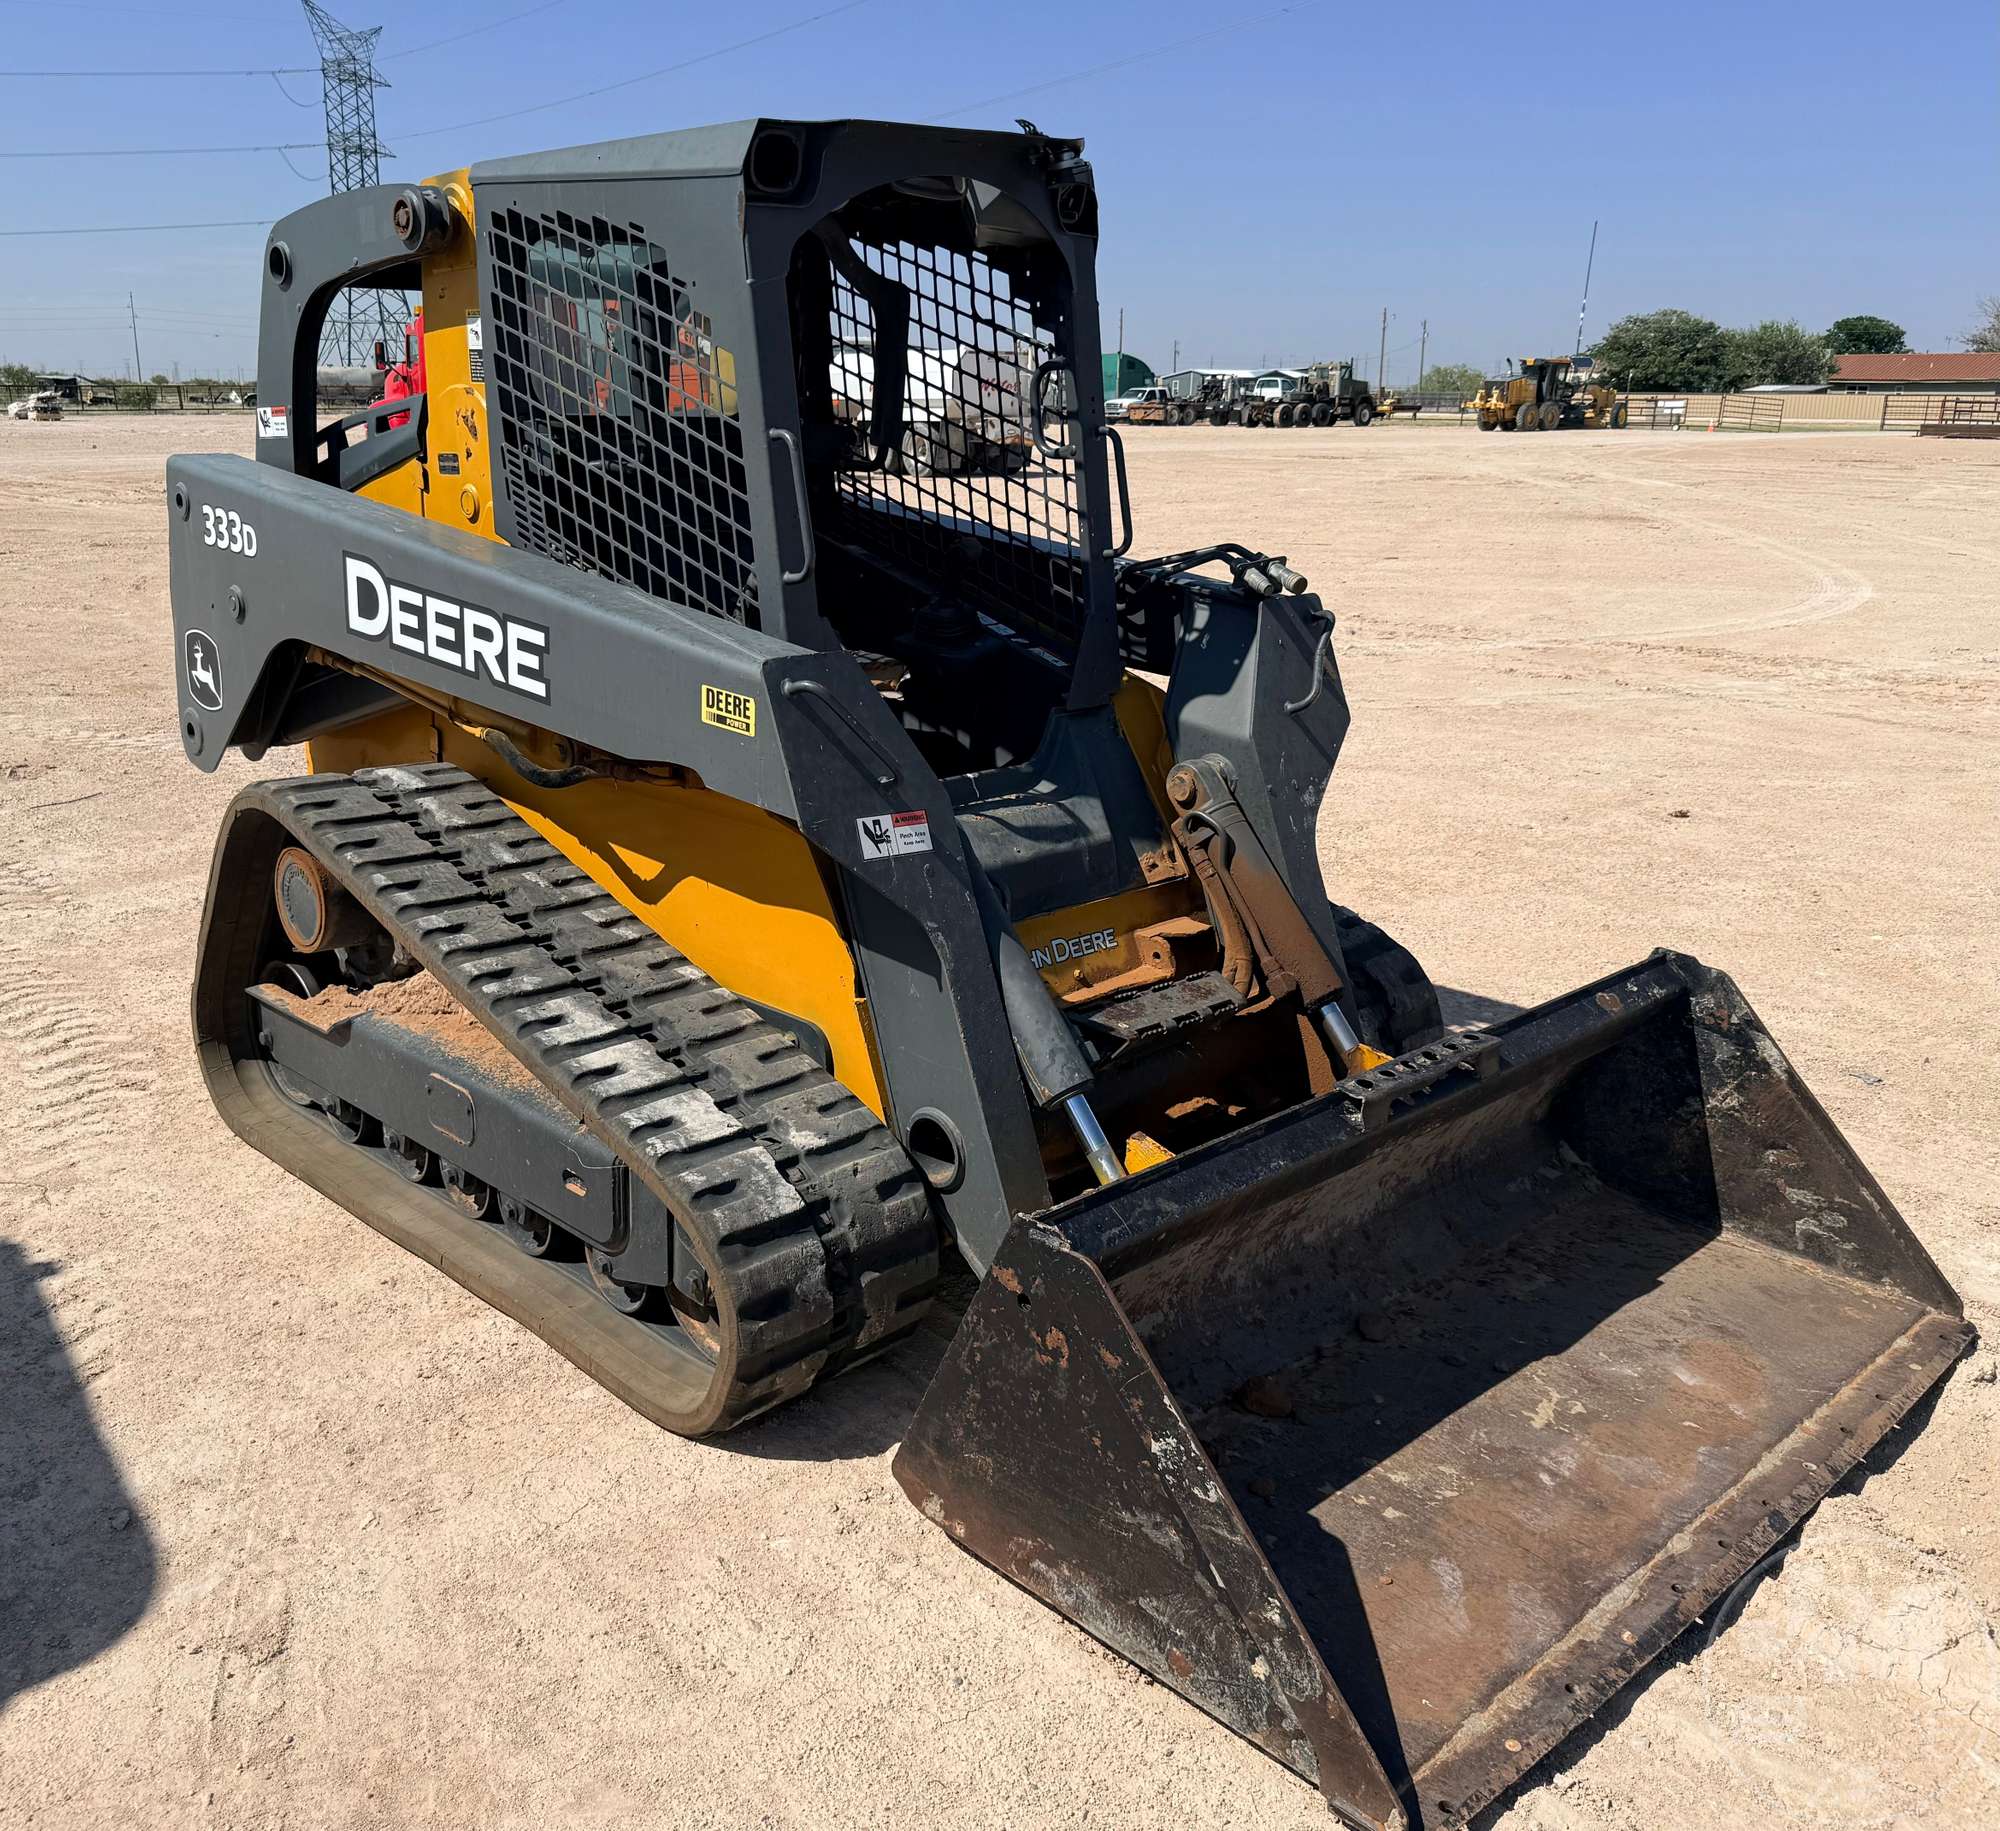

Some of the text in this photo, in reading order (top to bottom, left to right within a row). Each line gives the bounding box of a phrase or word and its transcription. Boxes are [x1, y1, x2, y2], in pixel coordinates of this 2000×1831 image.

[202, 504, 257, 557] 333D
[345, 556, 547, 698] DEERE
[706, 687, 751, 720] DEERE
[726, 718, 747, 731] POWER
[1051, 928, 1118, 963] DEERE
